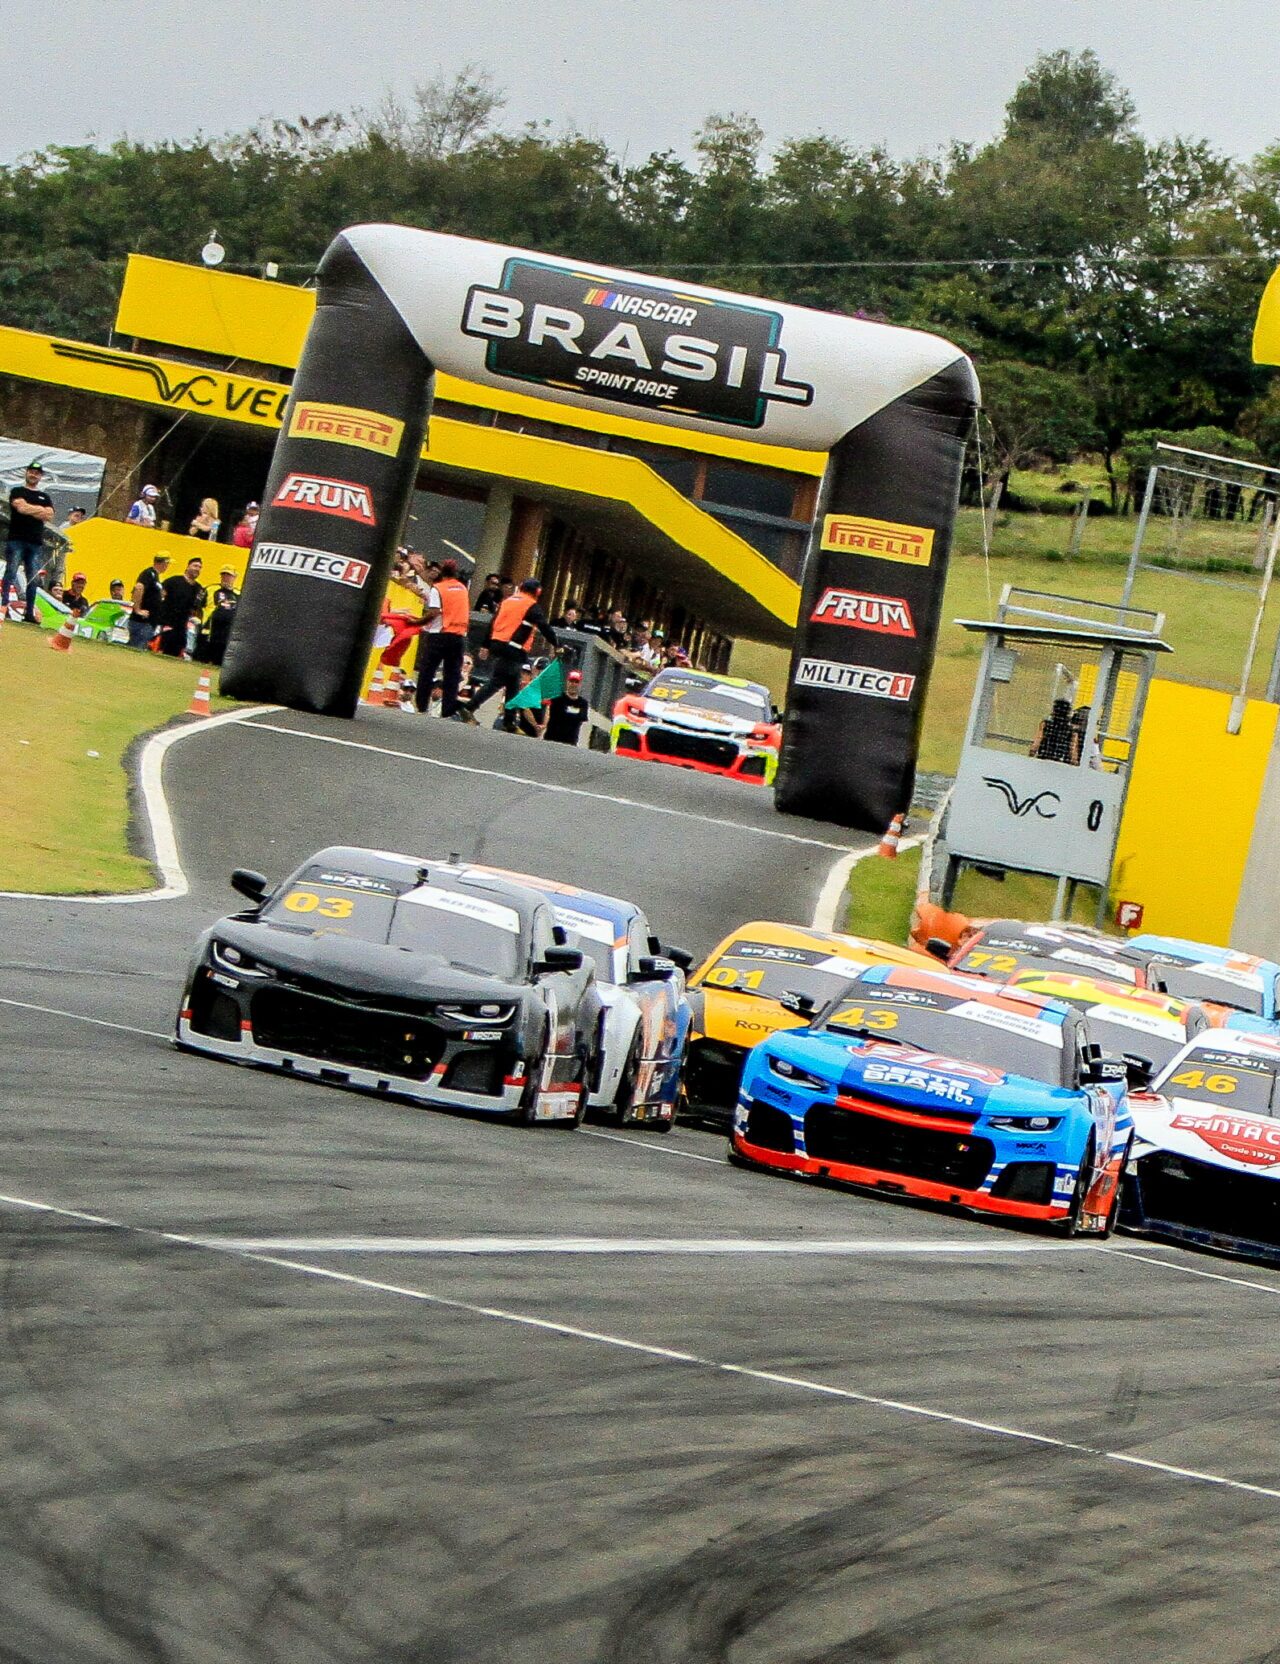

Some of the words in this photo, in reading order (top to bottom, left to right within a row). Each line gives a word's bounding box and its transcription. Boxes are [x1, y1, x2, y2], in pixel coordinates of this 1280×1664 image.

[612, 292, 698, 327] NASCAR
[466, 289, 809, 402] BRASIL
[576, 366, 636, 392] SPRINT
[635, 380, 679, 401] RACE
[297, 409, 394, 447] PIRELLI
[277, 476, 372, 518] FRUM
[829, 521, 924, 558] PIRELLI
[816, 590, 911, 630] FRUM
[320, 873, 392, 892] BRASIL
[284, 892, 354, 918] 03
[1120, 903, 1141, 926] F
[740, 946, 807, 961] BRASIL
[706, 967, 765, 989] 01
[869, 990, 938, 1007] BRASIL
[829, 1007, 899, 1030] 43
[1203, 1053, 1270, 1070] BRASIL
[863, 1069, 974, 1101] BRASIL
[866, 1063, 970, 1091] OESTE
[1170, 1070, 1239, 1094] 46
[1178, 1115, 1264, 1141] SANTA
[1221, 1143, 1250, 1156] Desde
